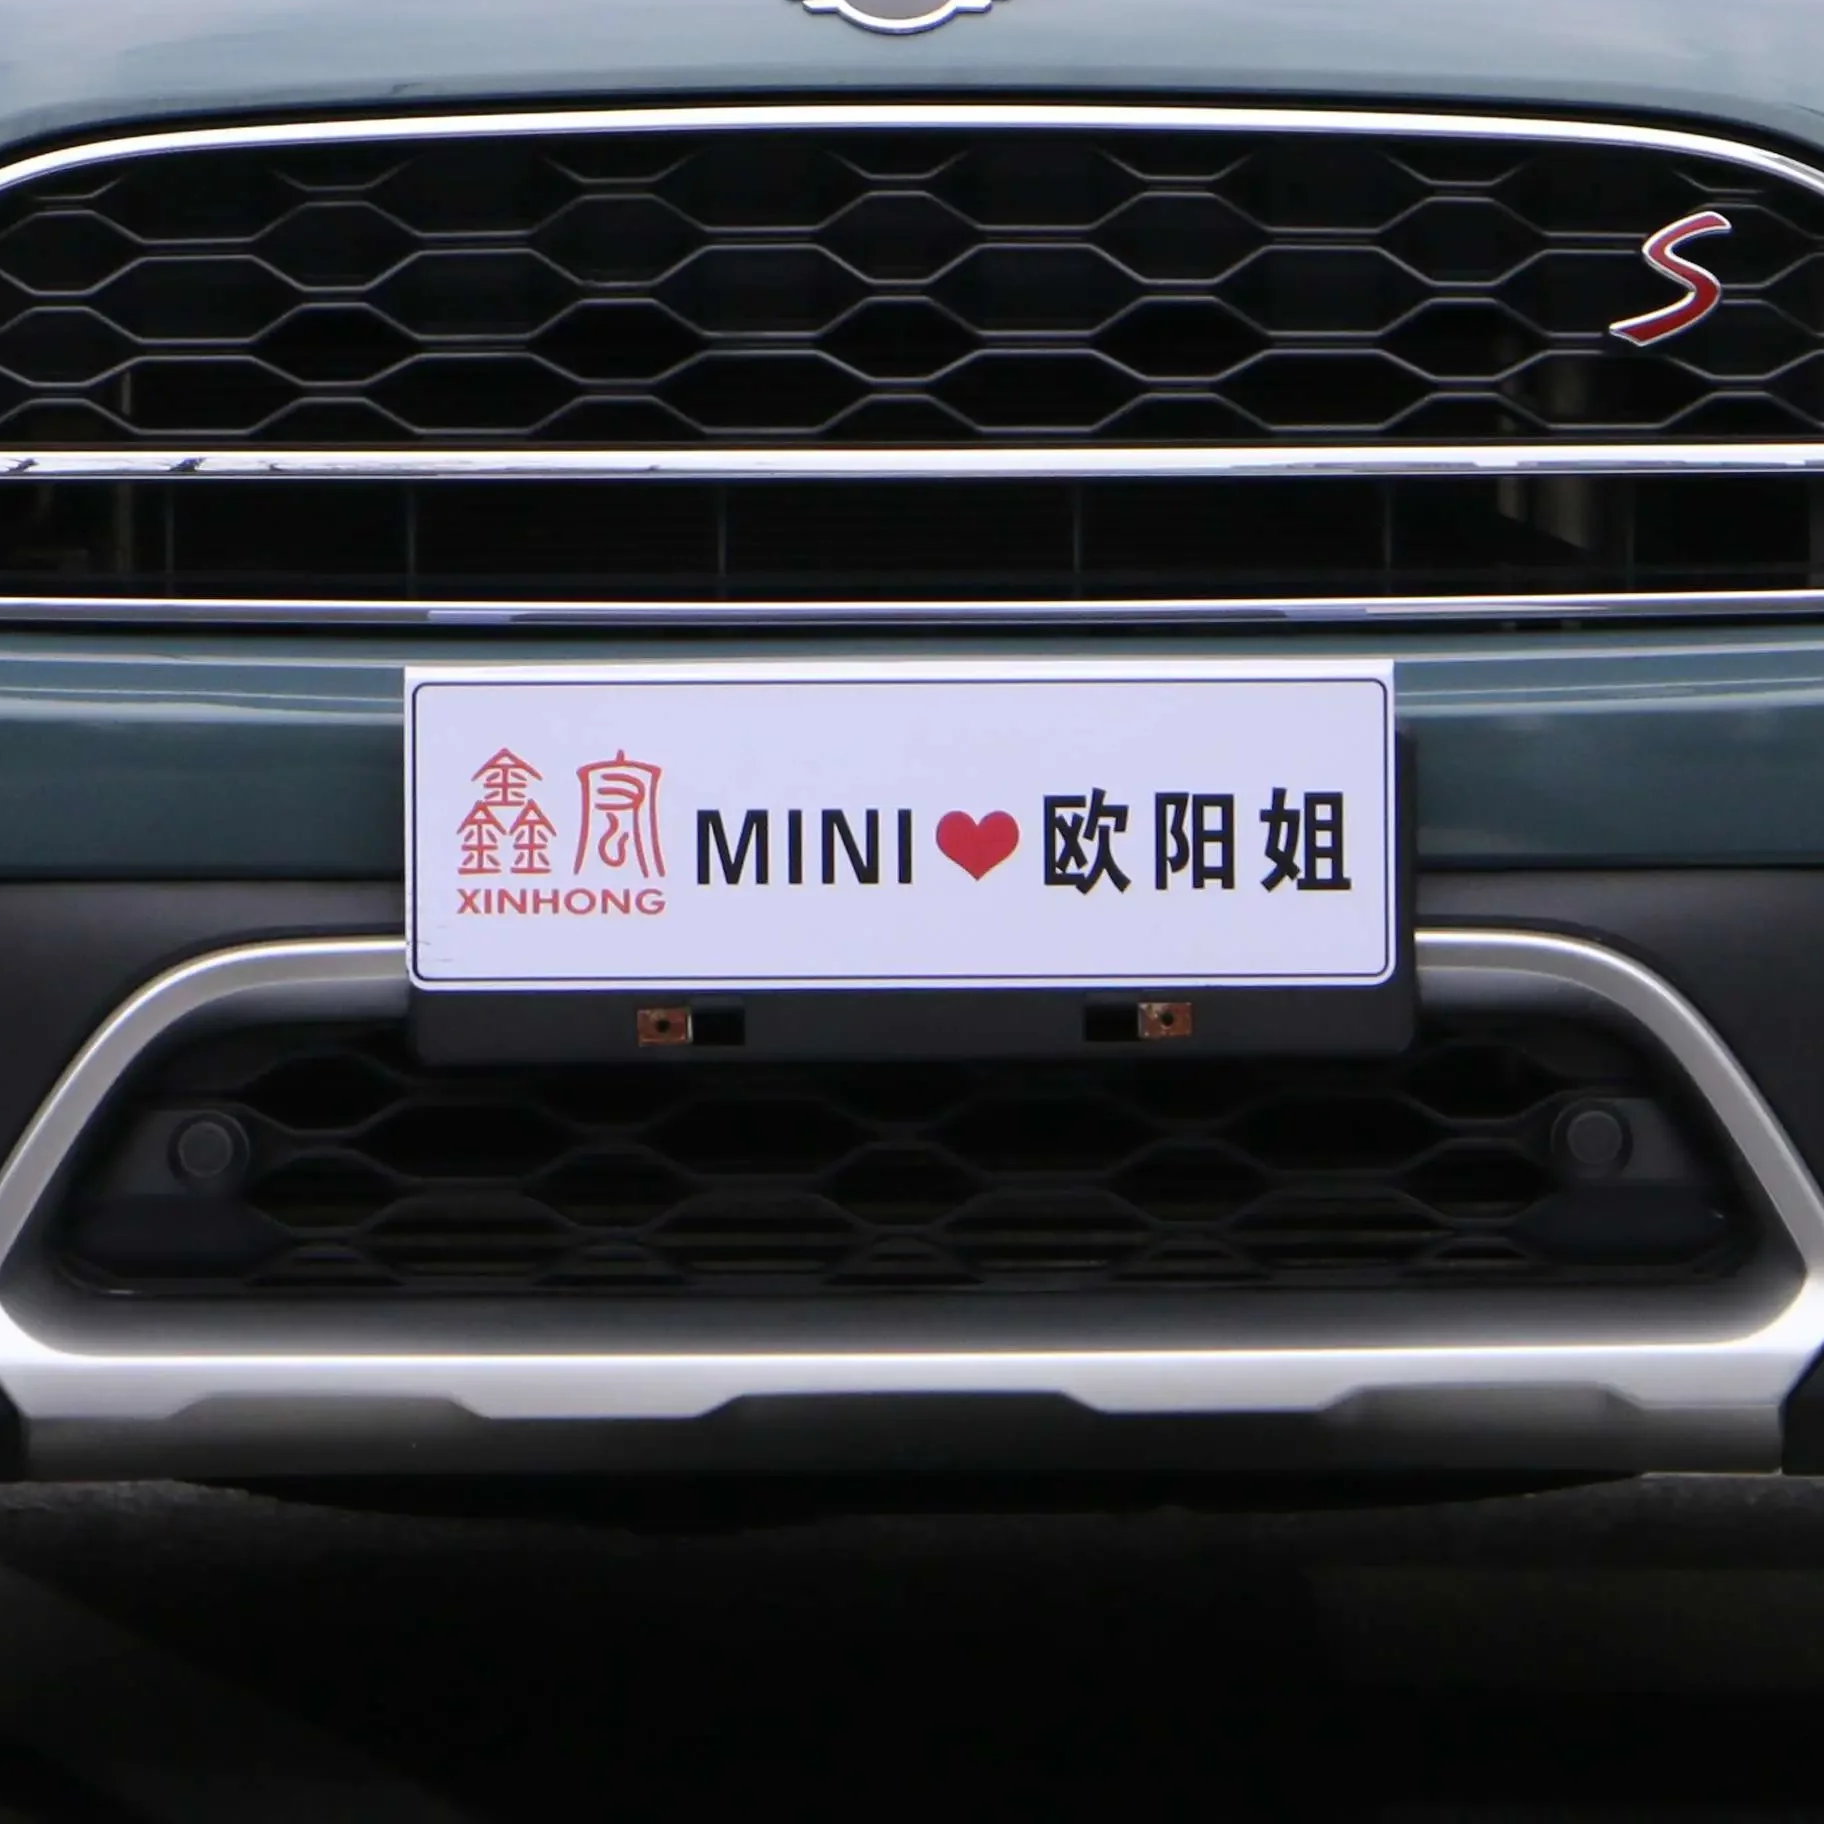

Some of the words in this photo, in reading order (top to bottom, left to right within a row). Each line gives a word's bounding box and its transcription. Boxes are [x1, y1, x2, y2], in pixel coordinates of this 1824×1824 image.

[1608, 210, 1733, 347] S
[696, 809, 914, 886] MINI
[1043, 787, 1353, 896] 欧阳姐
[456, 887, 667, 916] XINHONG
